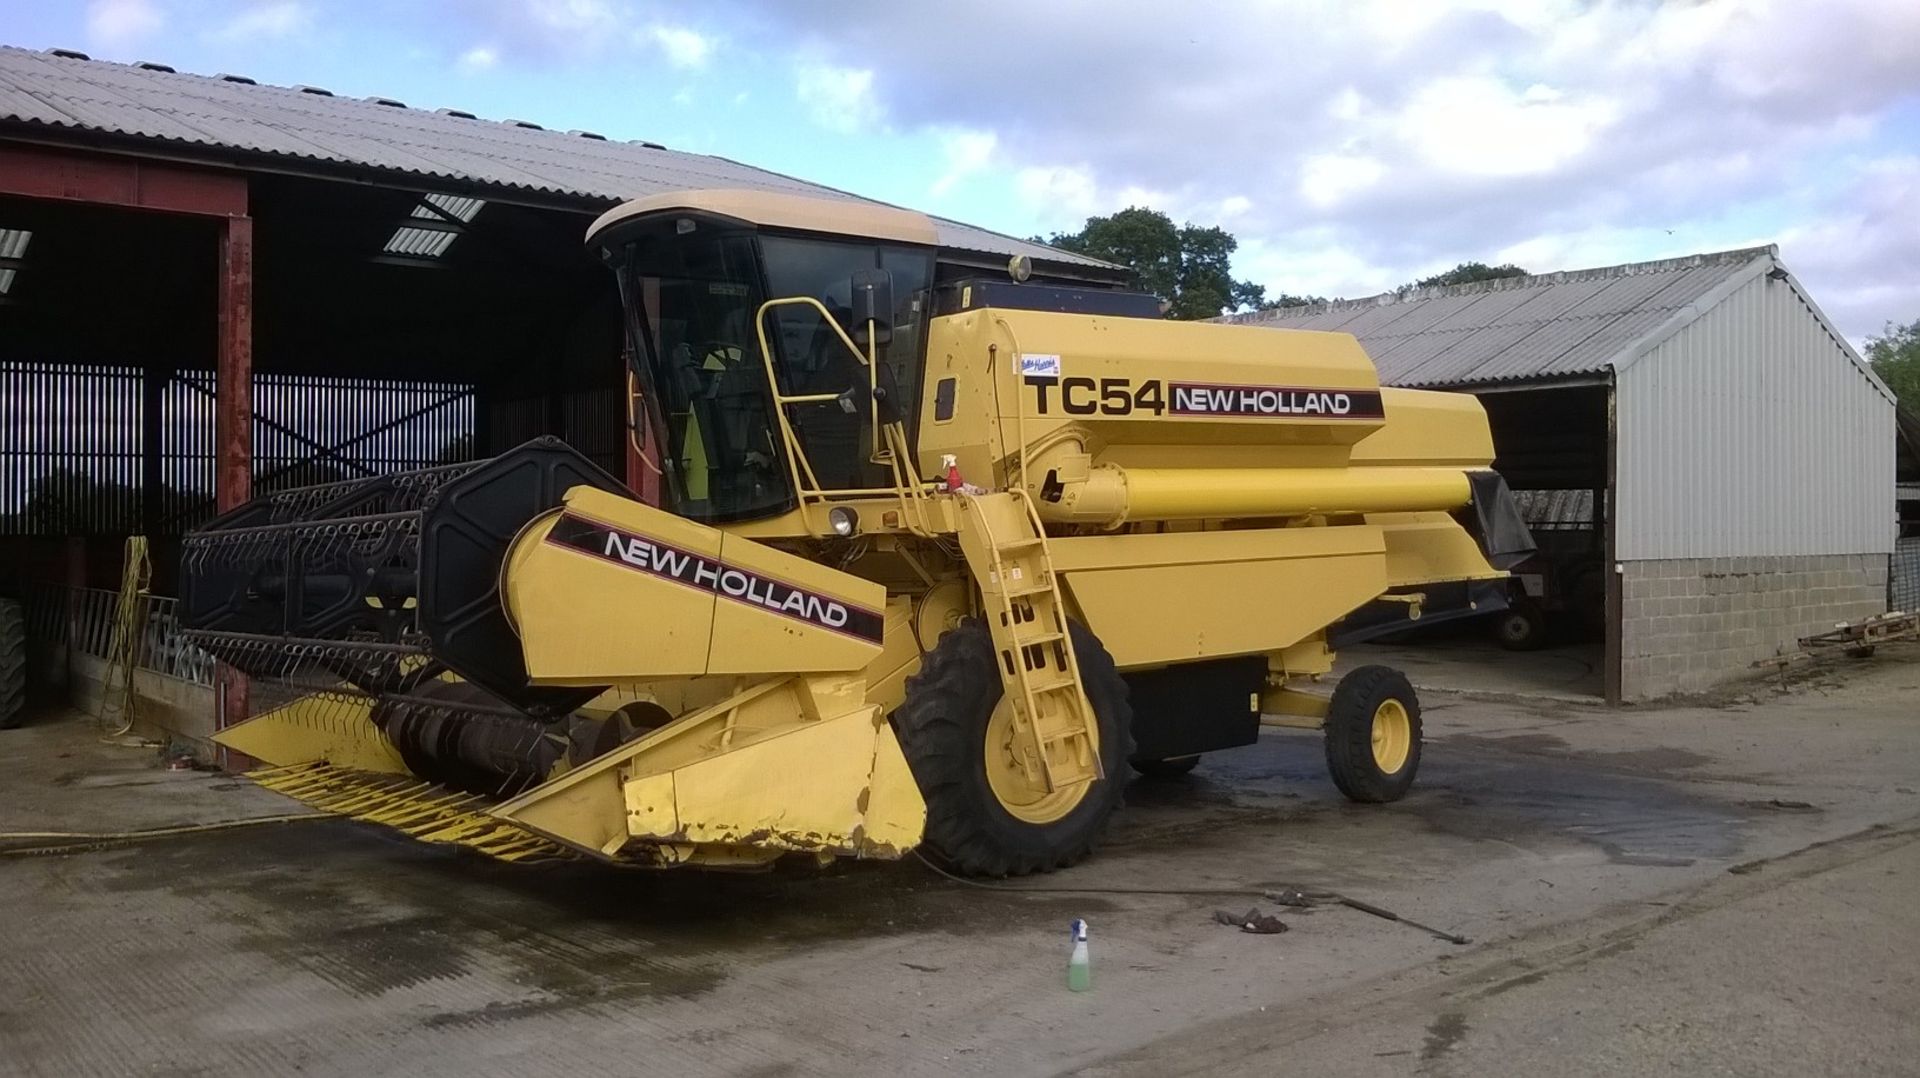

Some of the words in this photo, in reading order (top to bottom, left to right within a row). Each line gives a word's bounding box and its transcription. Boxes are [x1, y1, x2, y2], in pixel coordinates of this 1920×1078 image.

[1024, 376, 1165, 416] TC54
[1176, 388, 1234, 412] NEW
[1240, 391, 1350, 414] HOLLAND
[604, 532, 690, 577] NEW
[694, 560, 848, 627] HOLLAND
